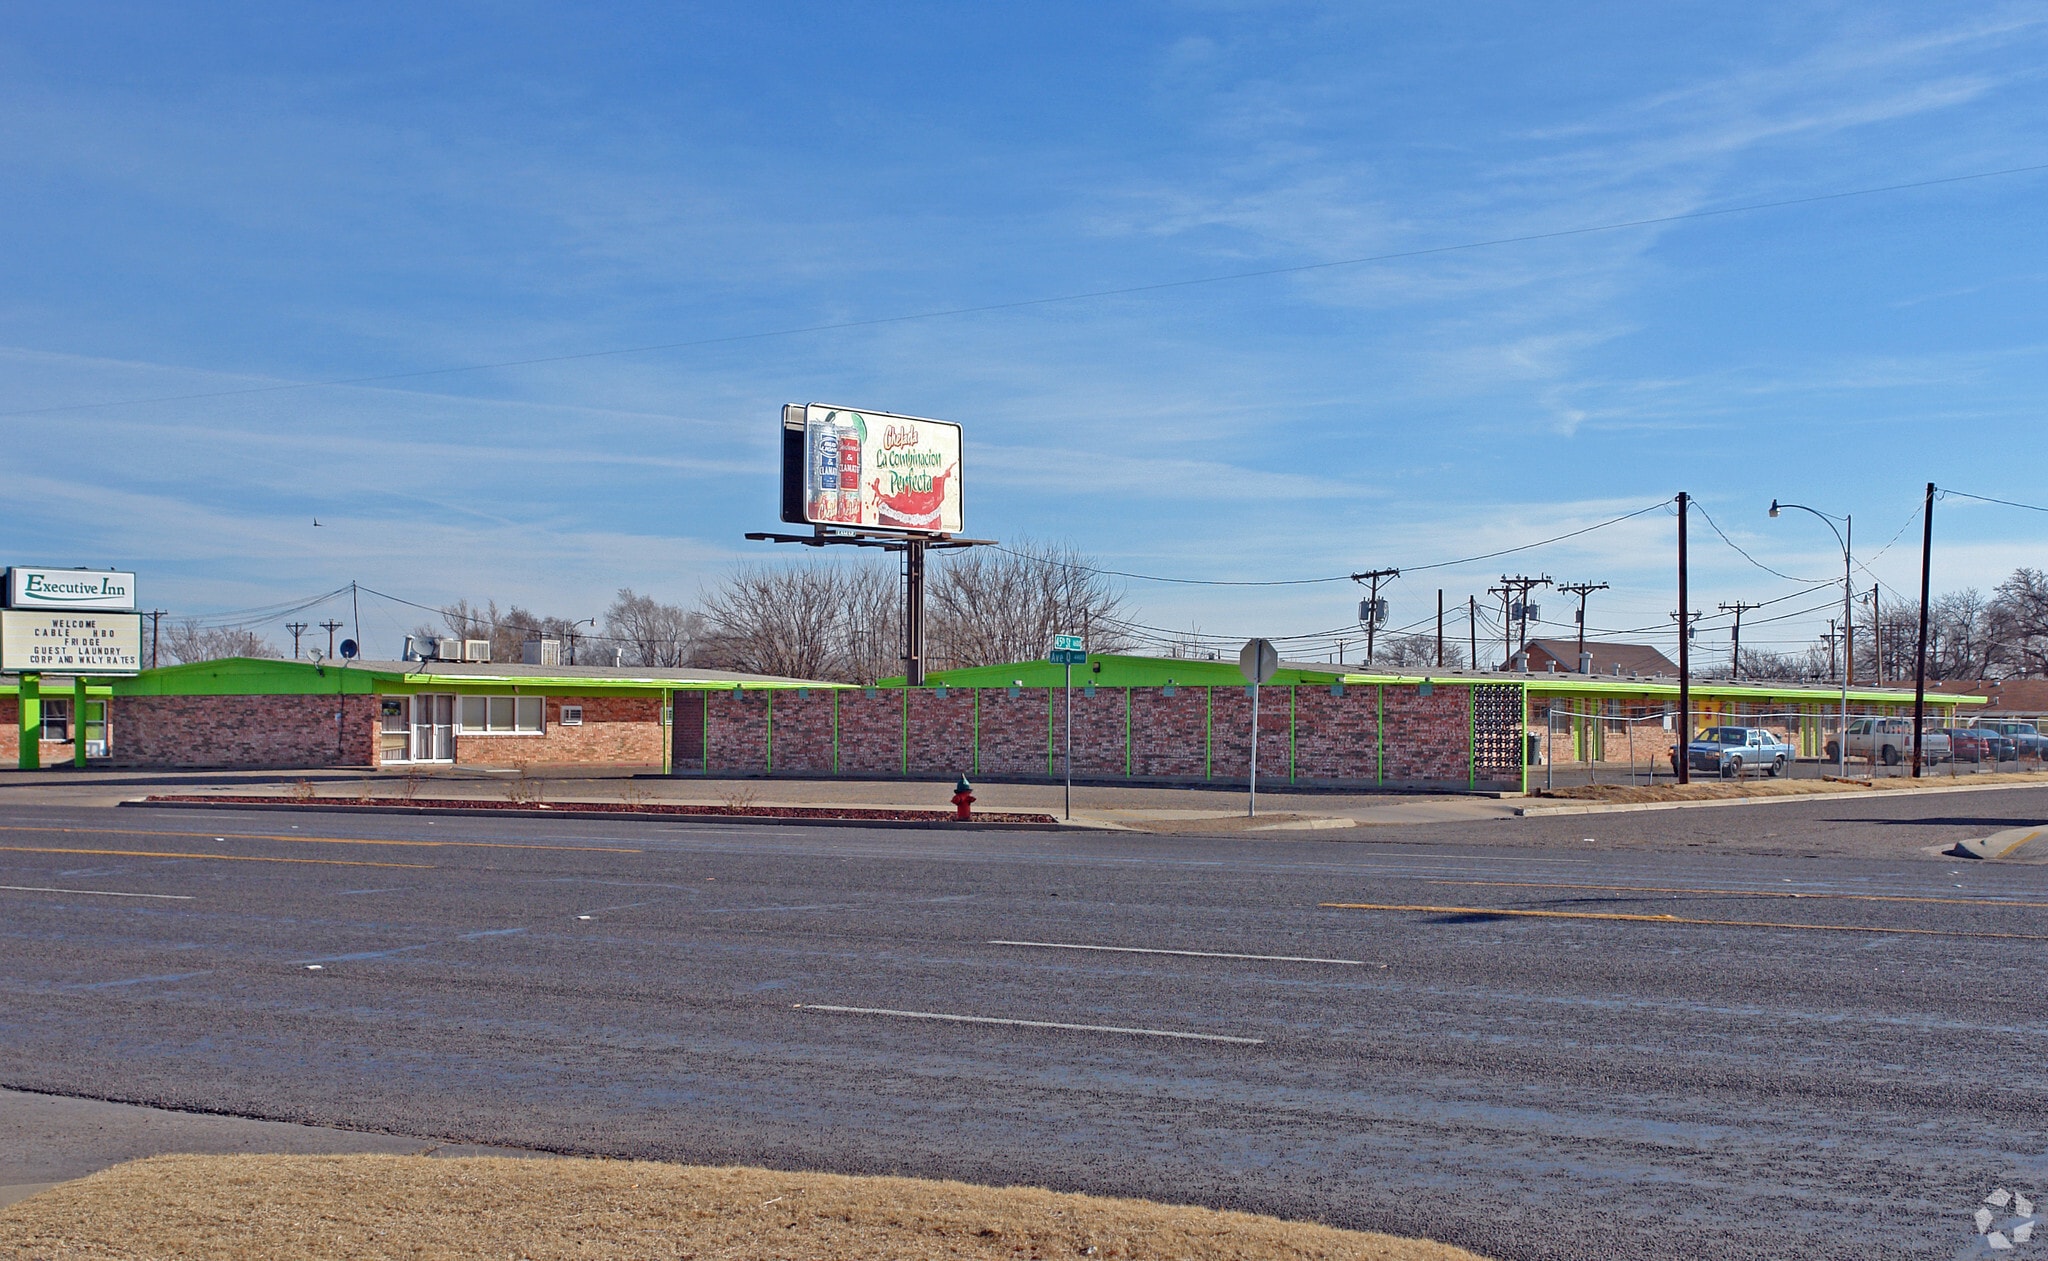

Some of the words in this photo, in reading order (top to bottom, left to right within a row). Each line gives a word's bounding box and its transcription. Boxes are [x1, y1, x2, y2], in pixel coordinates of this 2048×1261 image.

[884, 425, 918, 450] Chelada
[877, 448, 888, 469] La
[889, 468, 932, 496] Perfecta
[24, 574, 98, 594] Executive
[100, 577, 125, 595] Inn
[52, 619, 97, 628] WELCOME
[35, 629, 70, 637] CABLE
[64, 638, 100, 646] FRIDGE
[34, 647, 67, 655] GUEST
[78, 647, 121, 655] LAUNDRY
[1051, 652, 1064, 662] Ave
